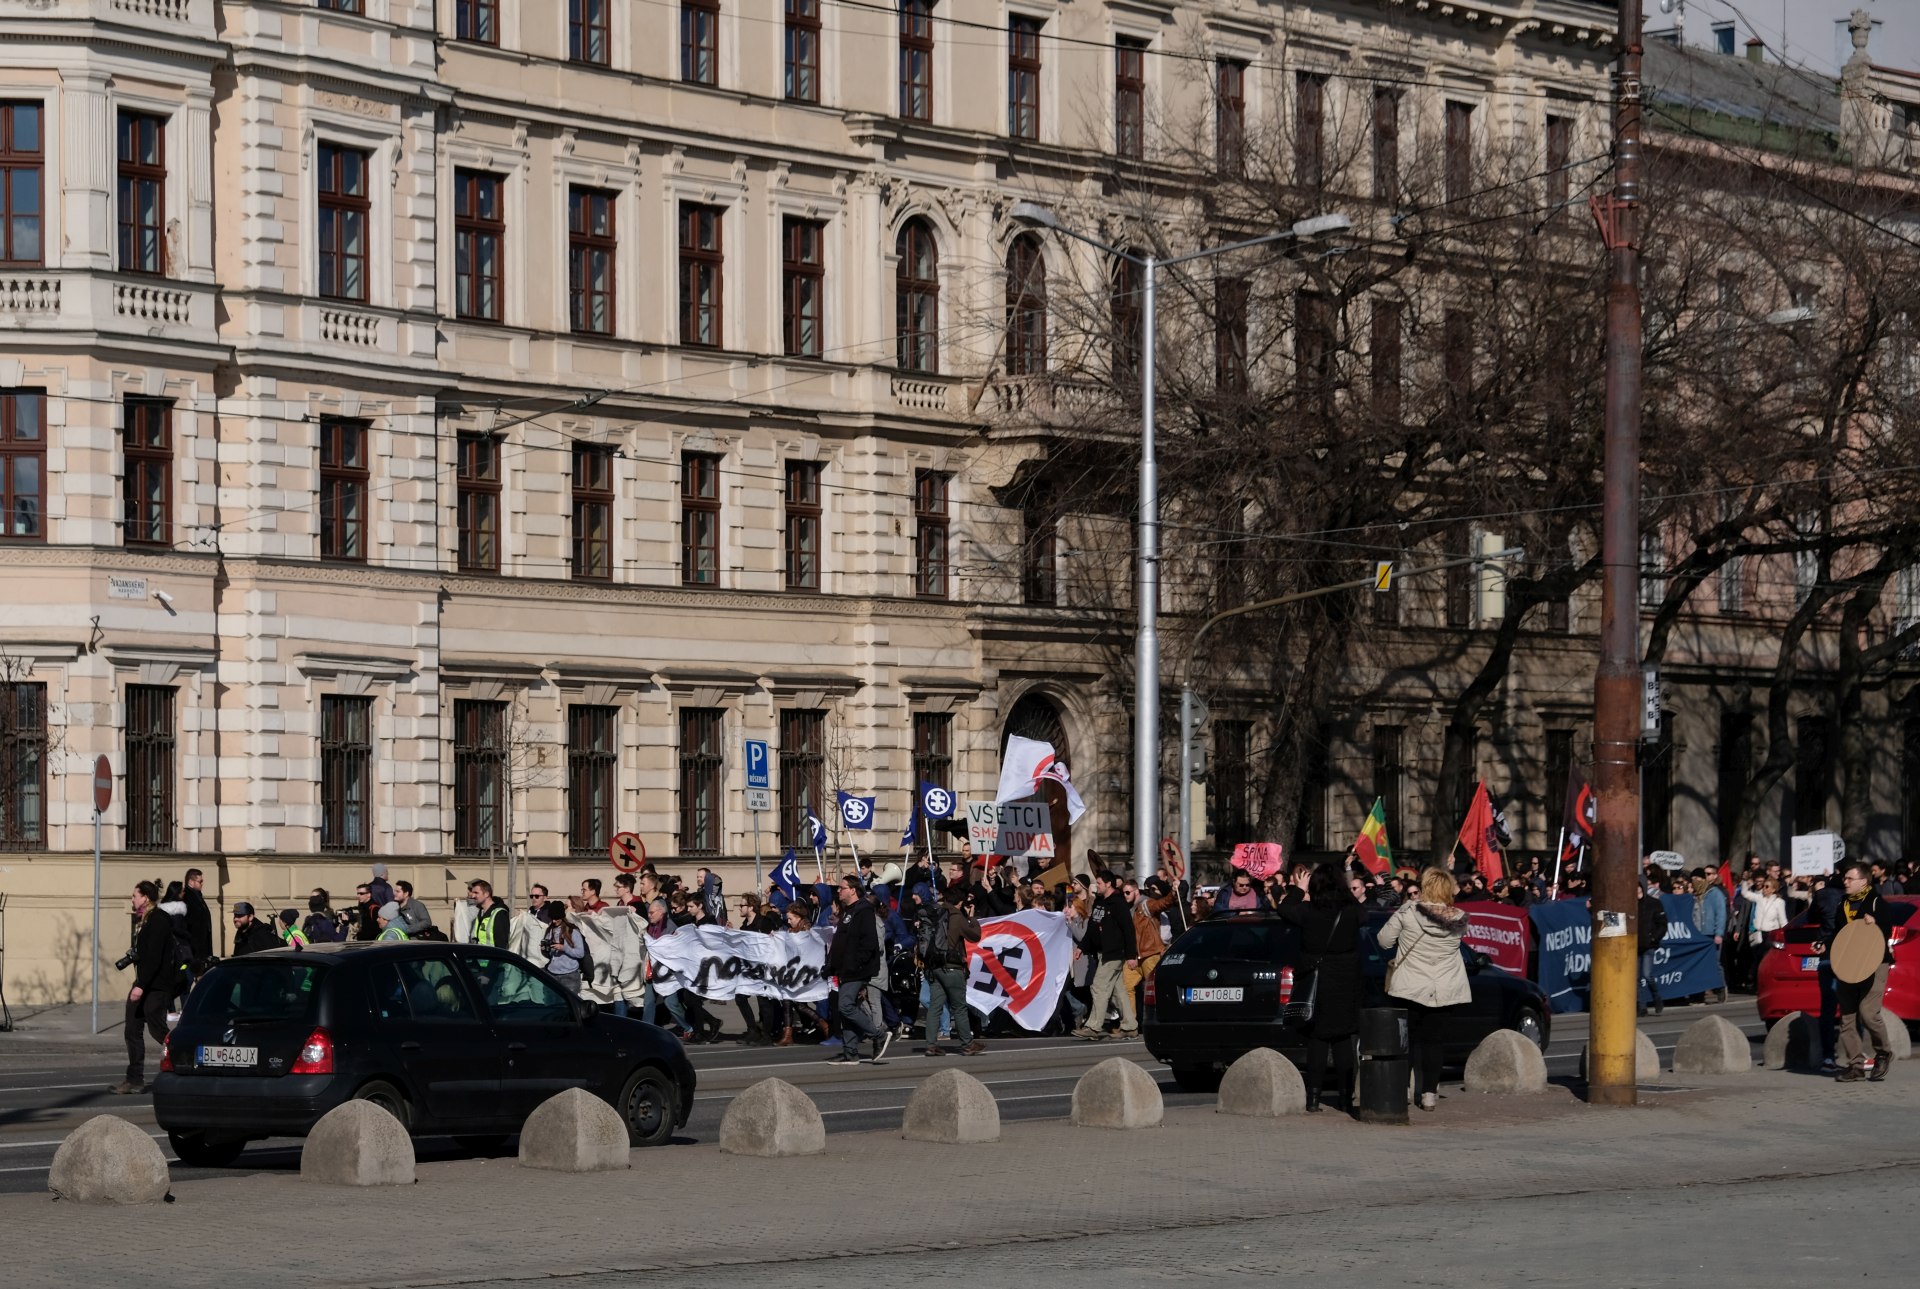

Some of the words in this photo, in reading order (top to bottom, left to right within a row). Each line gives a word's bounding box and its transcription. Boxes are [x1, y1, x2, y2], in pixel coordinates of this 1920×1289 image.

[751, 743, 763, 771] P
[969, 803, 1042, 829] VŠETCI
[971, 826, 998, 839] SME
[1004, 831, 1051, 852] DOMA
[1463, 925, 1491, 940] TRESS
[1490, 927, 1521, 946] EUROPE
